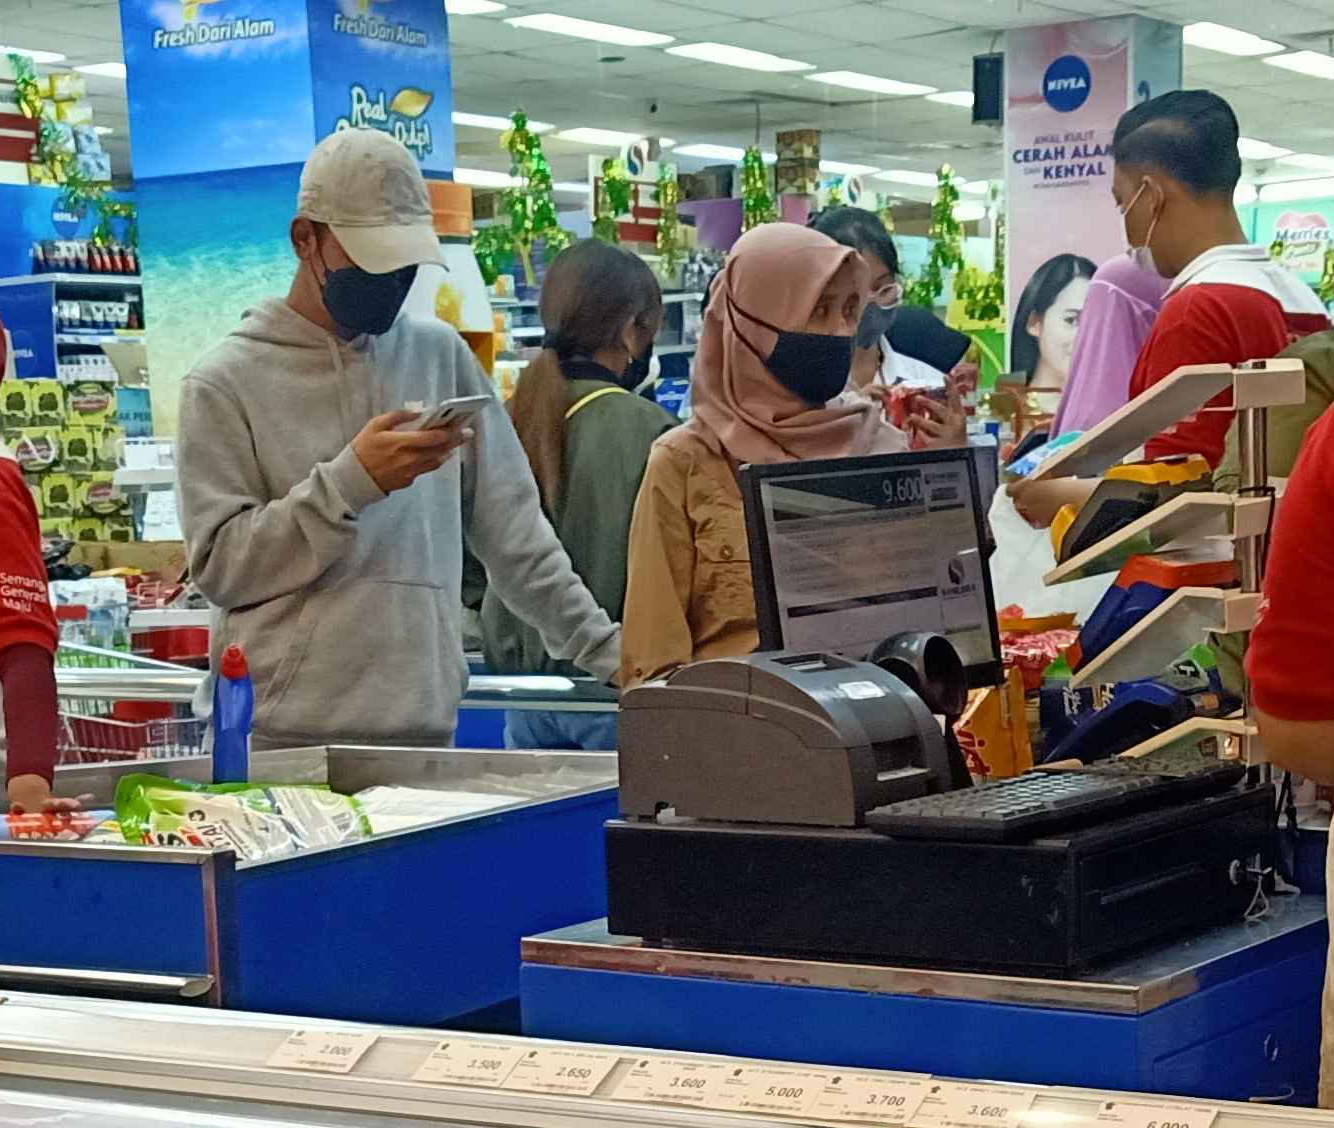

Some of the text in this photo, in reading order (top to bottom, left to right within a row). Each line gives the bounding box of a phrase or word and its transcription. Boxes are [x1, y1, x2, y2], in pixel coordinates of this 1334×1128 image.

[153, 19, 275, 48] Fresh Dari Alam
[334, 14, 427, 46] Fresh Dari Alam
[1048, 77, 1087, 91] NIVEA
[351, 86, 387, 126] Real
[1013, 146, 1065, 164] CERAH
[1043, 161, 1106, 179] KENYAL
[882, 475, 924, 503] 9.600
[468, 1058, 501, 1071] 3.500
[555, 1066, 593, 1079] 2.650
[669, 1077, 707, 1090] 3.600
[765, 1086, 804, 1099] 5.000
[866, 1094, 906, 1107] 3.700
